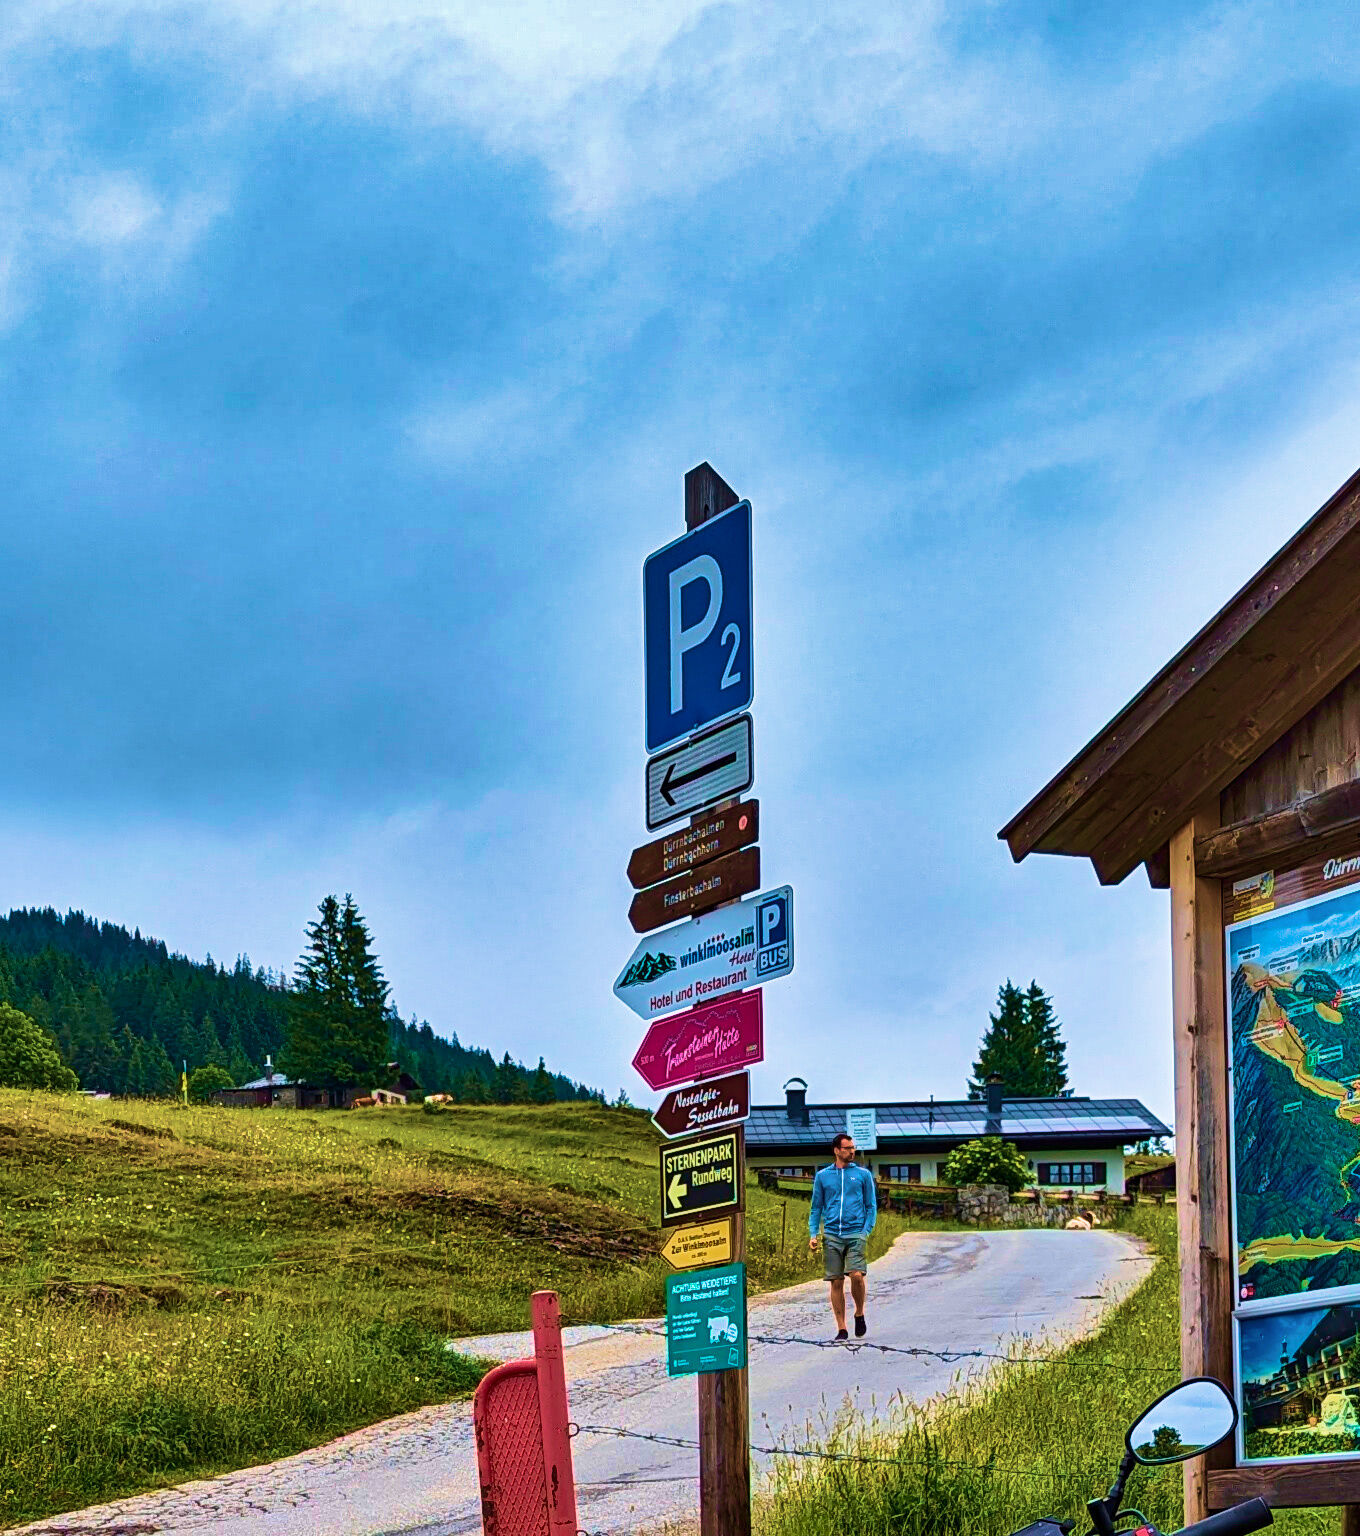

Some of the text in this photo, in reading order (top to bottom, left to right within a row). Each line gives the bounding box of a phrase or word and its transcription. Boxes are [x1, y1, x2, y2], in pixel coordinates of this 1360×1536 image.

[680, 929, 755, 968] winklmoosalm
[759, 946, 788, 969] BUS
[650, 967, 748, 1011] Hotel und Restaurant
[672, 1088, 721, 1113] Nostalgie-
[686, 1099, 739, 1129] Sesselbahn
[666, 1143, 732, 1173] STERNENPARK
[691, 1165, 733, 1187] Rundweg
